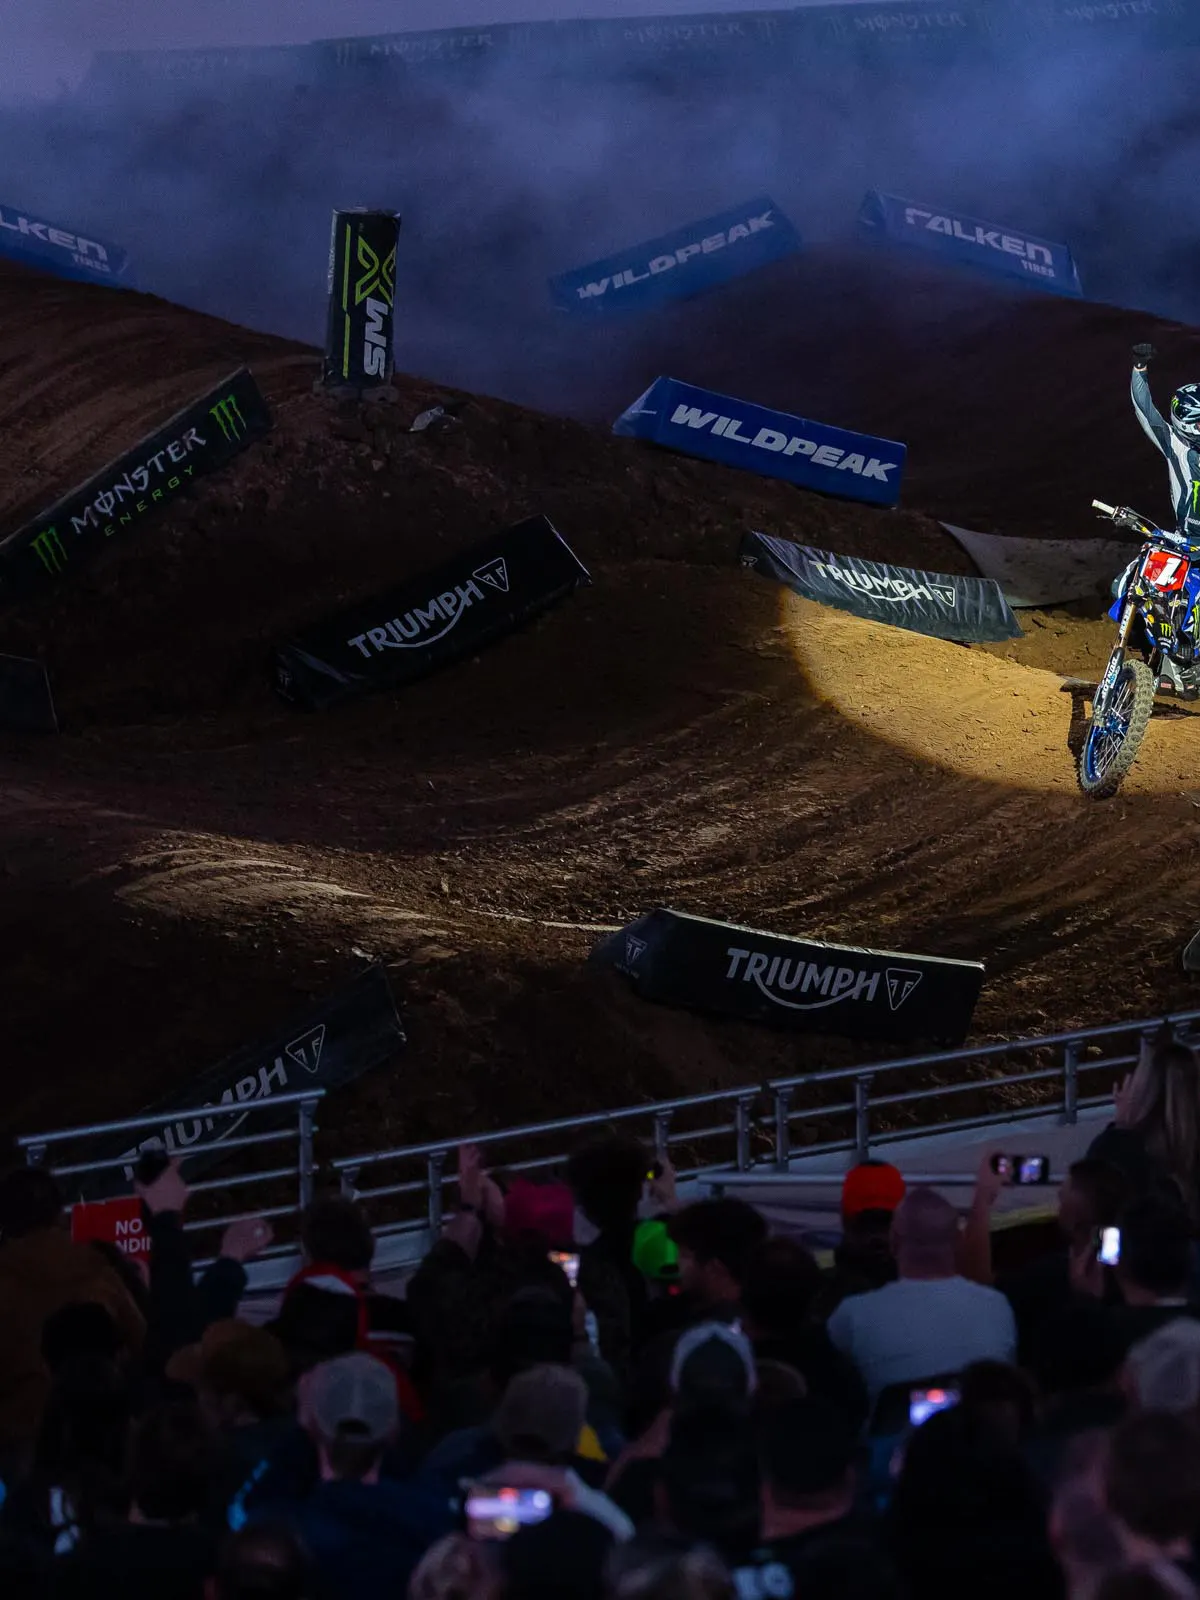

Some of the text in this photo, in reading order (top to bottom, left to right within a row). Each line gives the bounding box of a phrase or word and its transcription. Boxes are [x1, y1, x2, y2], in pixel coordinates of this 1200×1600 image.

[575, 210, 775, 299] WILDPEAK
[904, 207, 1053, 266] FALKEN
[669, 403, 899, 483] WILDPEAK
[69, 426, 207, 535] MONSTER
[103, 464, 193, 537] ENERGY
[809, 559, 933, 602] TRIUMPH
[1153, 557, 1182, 586] 1
[346, 579, 486, 659] TRIUMPH
[725, 946, 880, 1010] TRIUMPH
[115, 1217, 144, 1237] NO
